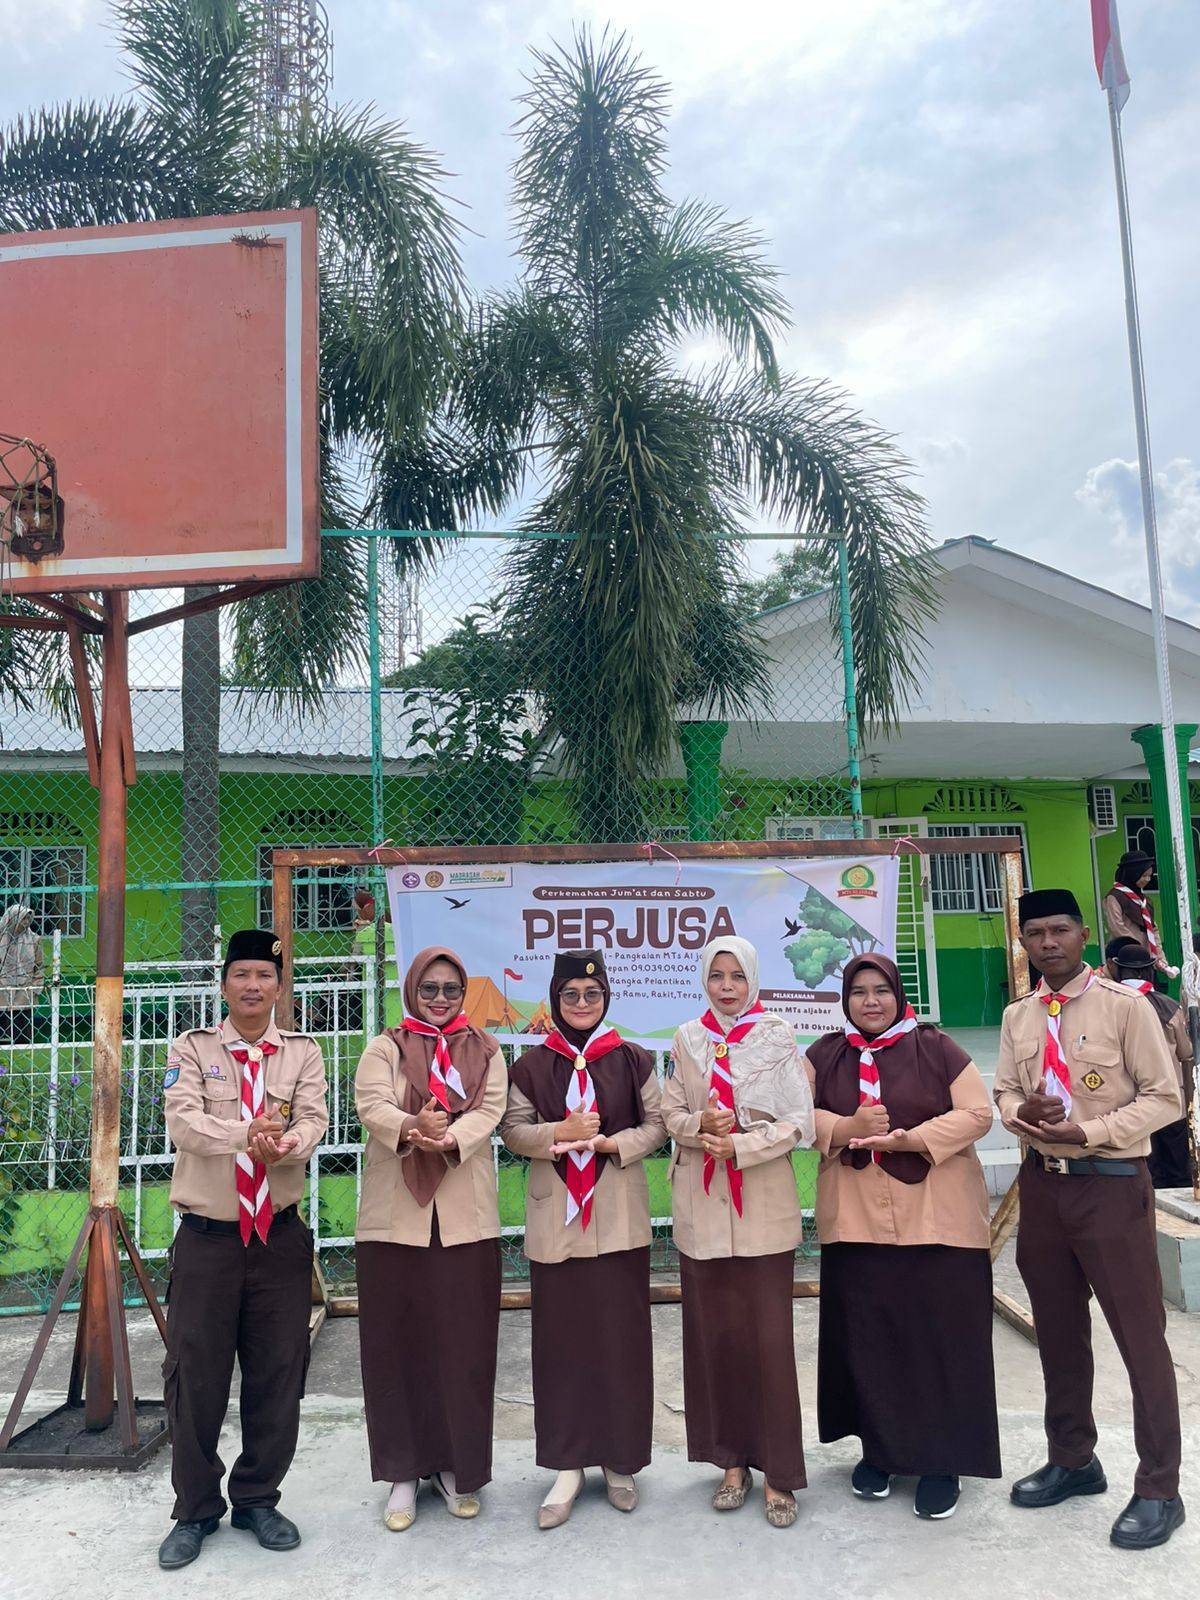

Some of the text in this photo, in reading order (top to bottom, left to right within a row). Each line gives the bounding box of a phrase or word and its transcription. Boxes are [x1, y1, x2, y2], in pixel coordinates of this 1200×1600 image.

[541, 888, 707, 897] Perkemahan Jum'at dan Sabtu
[522, 907, 736, 950] PERJUSA
[615, 952, 661, 962] Pangkalan
[663, 952, 681, 960] MTs
[610, 977, 691, 987] Rangka Pelantikan
[623, 990, 649, 999] Ramu,
[773, 992, 815, 1000] PELAKSANAAN
[785, 1006, 801, 1014] MTs
